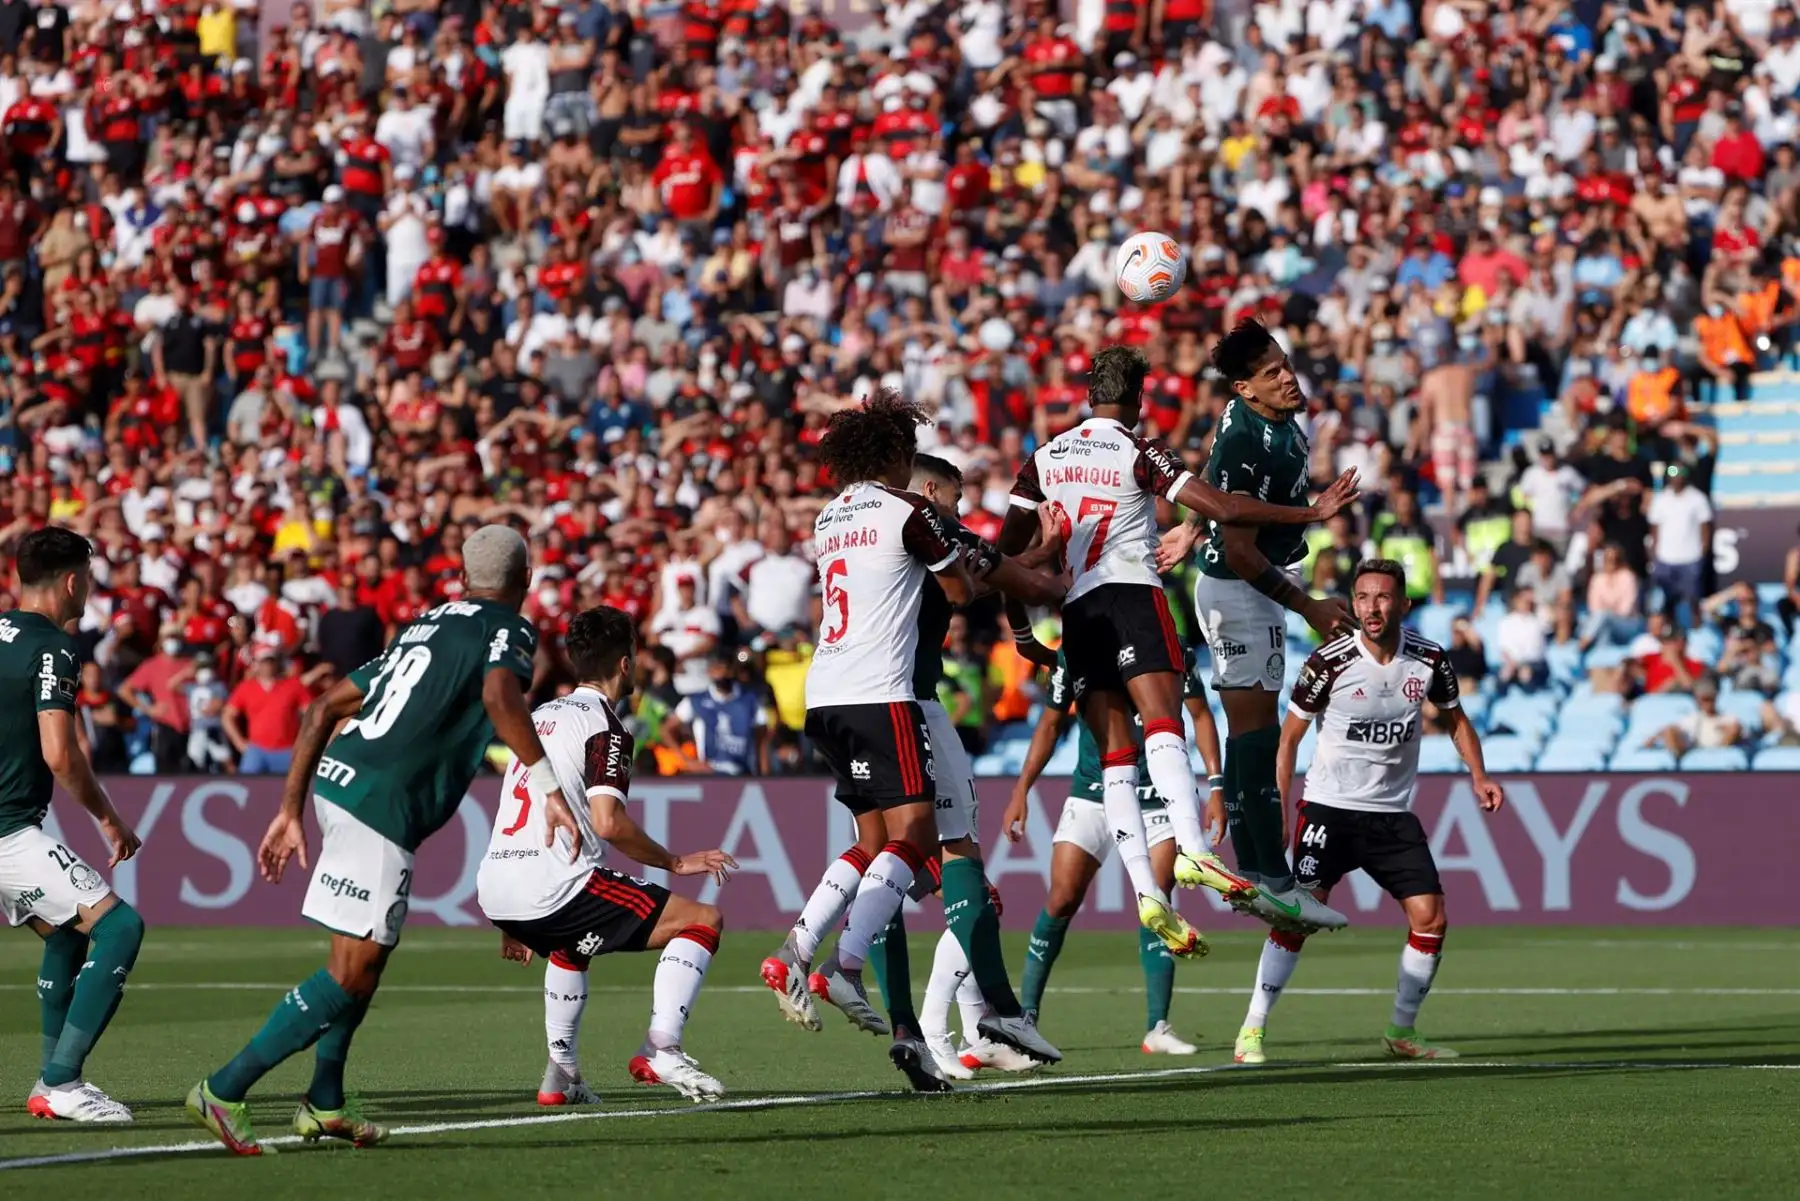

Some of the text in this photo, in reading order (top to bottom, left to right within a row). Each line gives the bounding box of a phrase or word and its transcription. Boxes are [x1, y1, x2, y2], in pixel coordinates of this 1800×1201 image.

[1069, 446, 1092, 457] livre
[1071, 438, 1121, 452] mercado
[833, 512, 854, 525] livre
[838, 499, 882, 513] mercado
[843, 527, 878, 549] ARÃO
[823, 558, 849, 644] 5
[1268, 625, 1283, 649] 15
[39, 652, 57, 700] crefisa
[1373, 721, 1416, 745] BRB
[606, 733, 622, 778] HAVAN
[316, 755, 356, 788] am
[1302, 823, 1327, 849] 44
[48, 844, 77, 871] 22
[320, 871, 371, 902] crefisa
